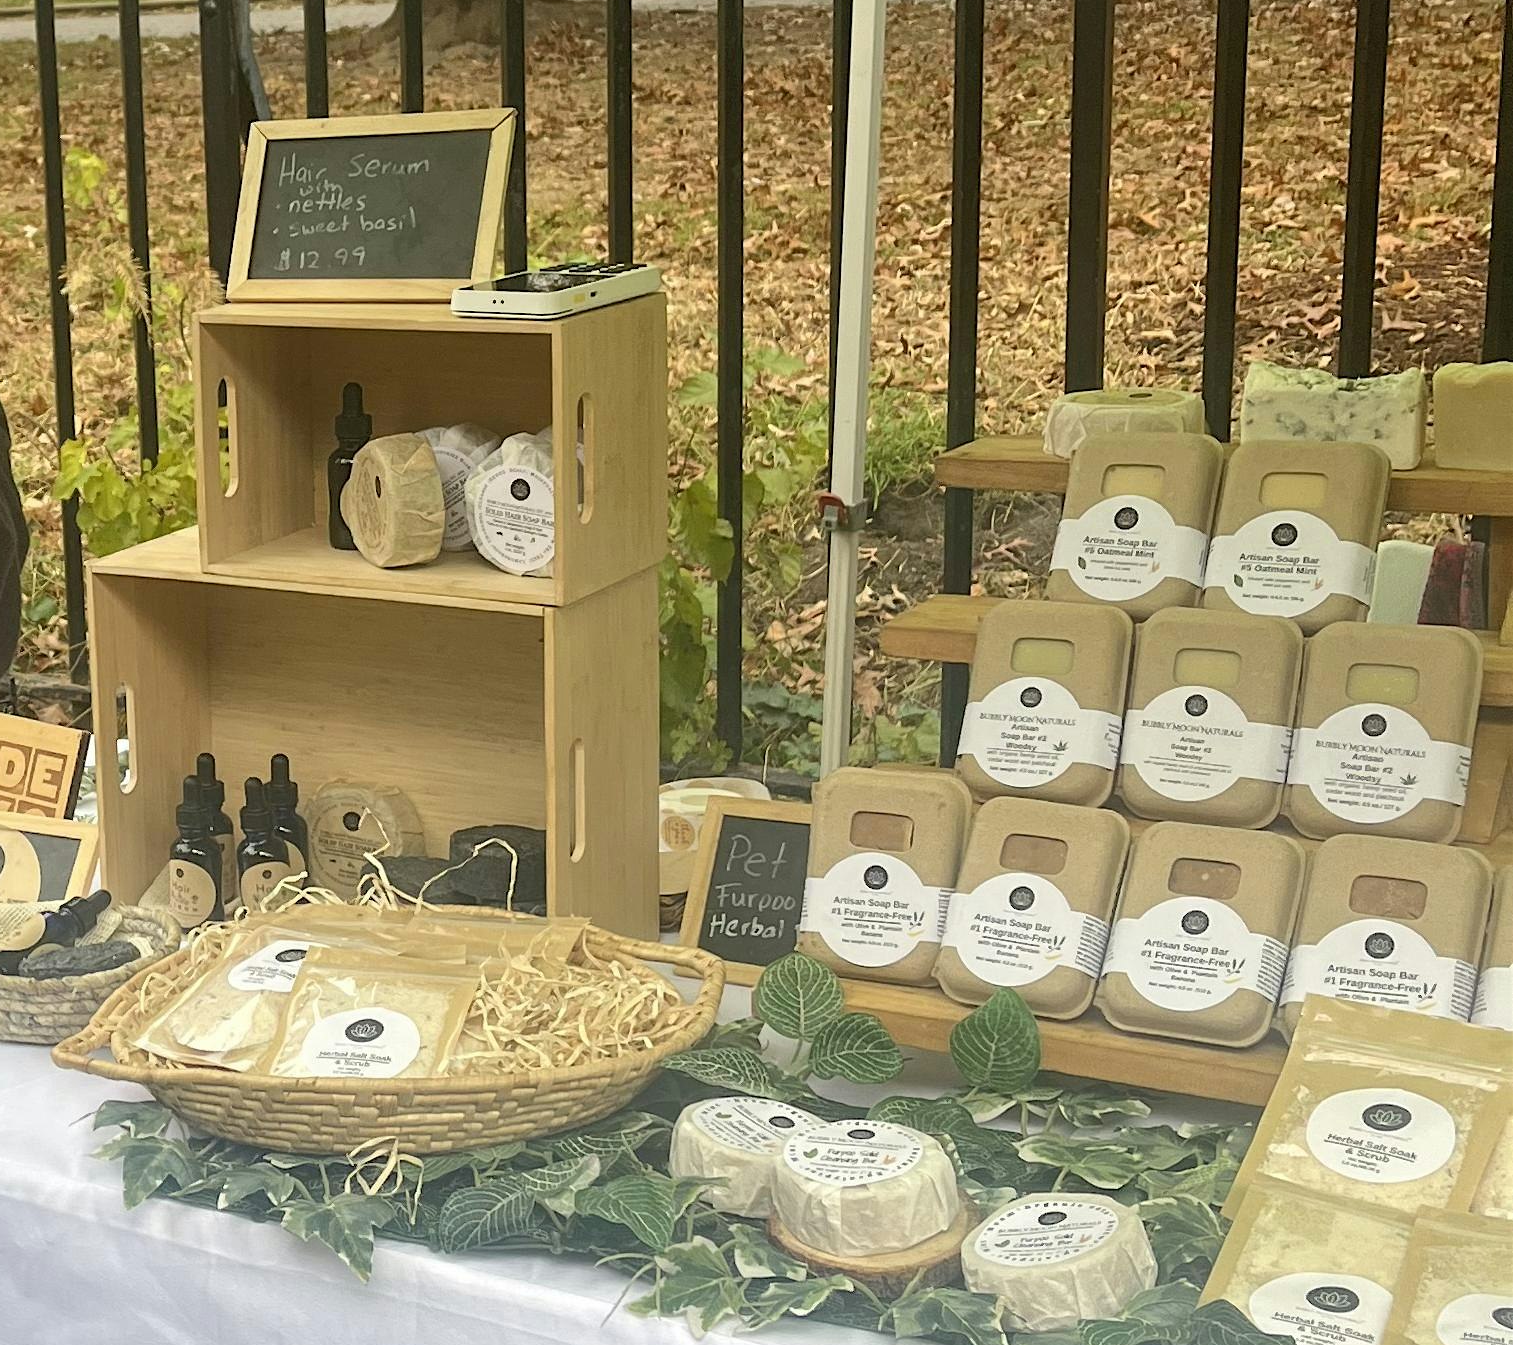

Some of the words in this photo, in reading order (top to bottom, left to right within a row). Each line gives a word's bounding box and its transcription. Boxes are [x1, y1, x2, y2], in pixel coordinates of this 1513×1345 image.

[278, 152, 328, 187] Hair
[348, 154, 430, 178] Serum
[299, 181, 343, 197] with
[288, 192, 367, 213] nettles
[288, 218, 350, 237] sweet
[360, 207, 417, 231] basil
[1083, 536, 1115, 545] Artisan
[1117, 538, 1140, 548] Soap
[1097, 548, 1133, 556] Oatmeal
[1239, 553, 1273, 561] Artisan
[1276, 556, 1300, 565] Soap
[1254, 565, 1294, 574] Oatmeal
[1340, 762, 1362, 771] Soap
[726, 834, 787, 878] Pet
[715, 882, 796, 912] Furpoo
[833, 896, 866, 906] Artisan
[868, 899, 891, 909] Soap
[894, 901, 910, 909] Bar
[831, 907, 842, 915] #1
[844, 908, 912, 921] Fragrance-Free
[709, 913, 785, 939] Herbal
[974, 913, 1007, 926] Artisan
[1009, 919, 1032, 931] Soap
[1035, 924, 1052, 933] Bar
[970, 925, 980, 933] #1
[983, 926, 1052, 944] Fragrance-Free
[1144, 939, 1180, 951] Artisan
[1183, 944, 1209, 955] Soap
[1211, 947, 1229, 955] Bar
[1155, 951, 1230, 968] Fragrance-Free
[1327, 964, 1366, 976] Artisan
[1369, 969, 1396, 980] Soap
[1399, 971, 1419, 981] Bar
[1324, 976, 1336, 985] #1
[1339, 977, 1421, 993] Fragrance-Free
[1327, 1134, 1364, 1146] Herbal
[1365, 1141, 1387, 1152] Salt
[1389, 1147, 1418, 1160] Soak
[1357, 1149, 1390, 1163] Scrub
[1275, 1312, 1314, 1324] Herbal
